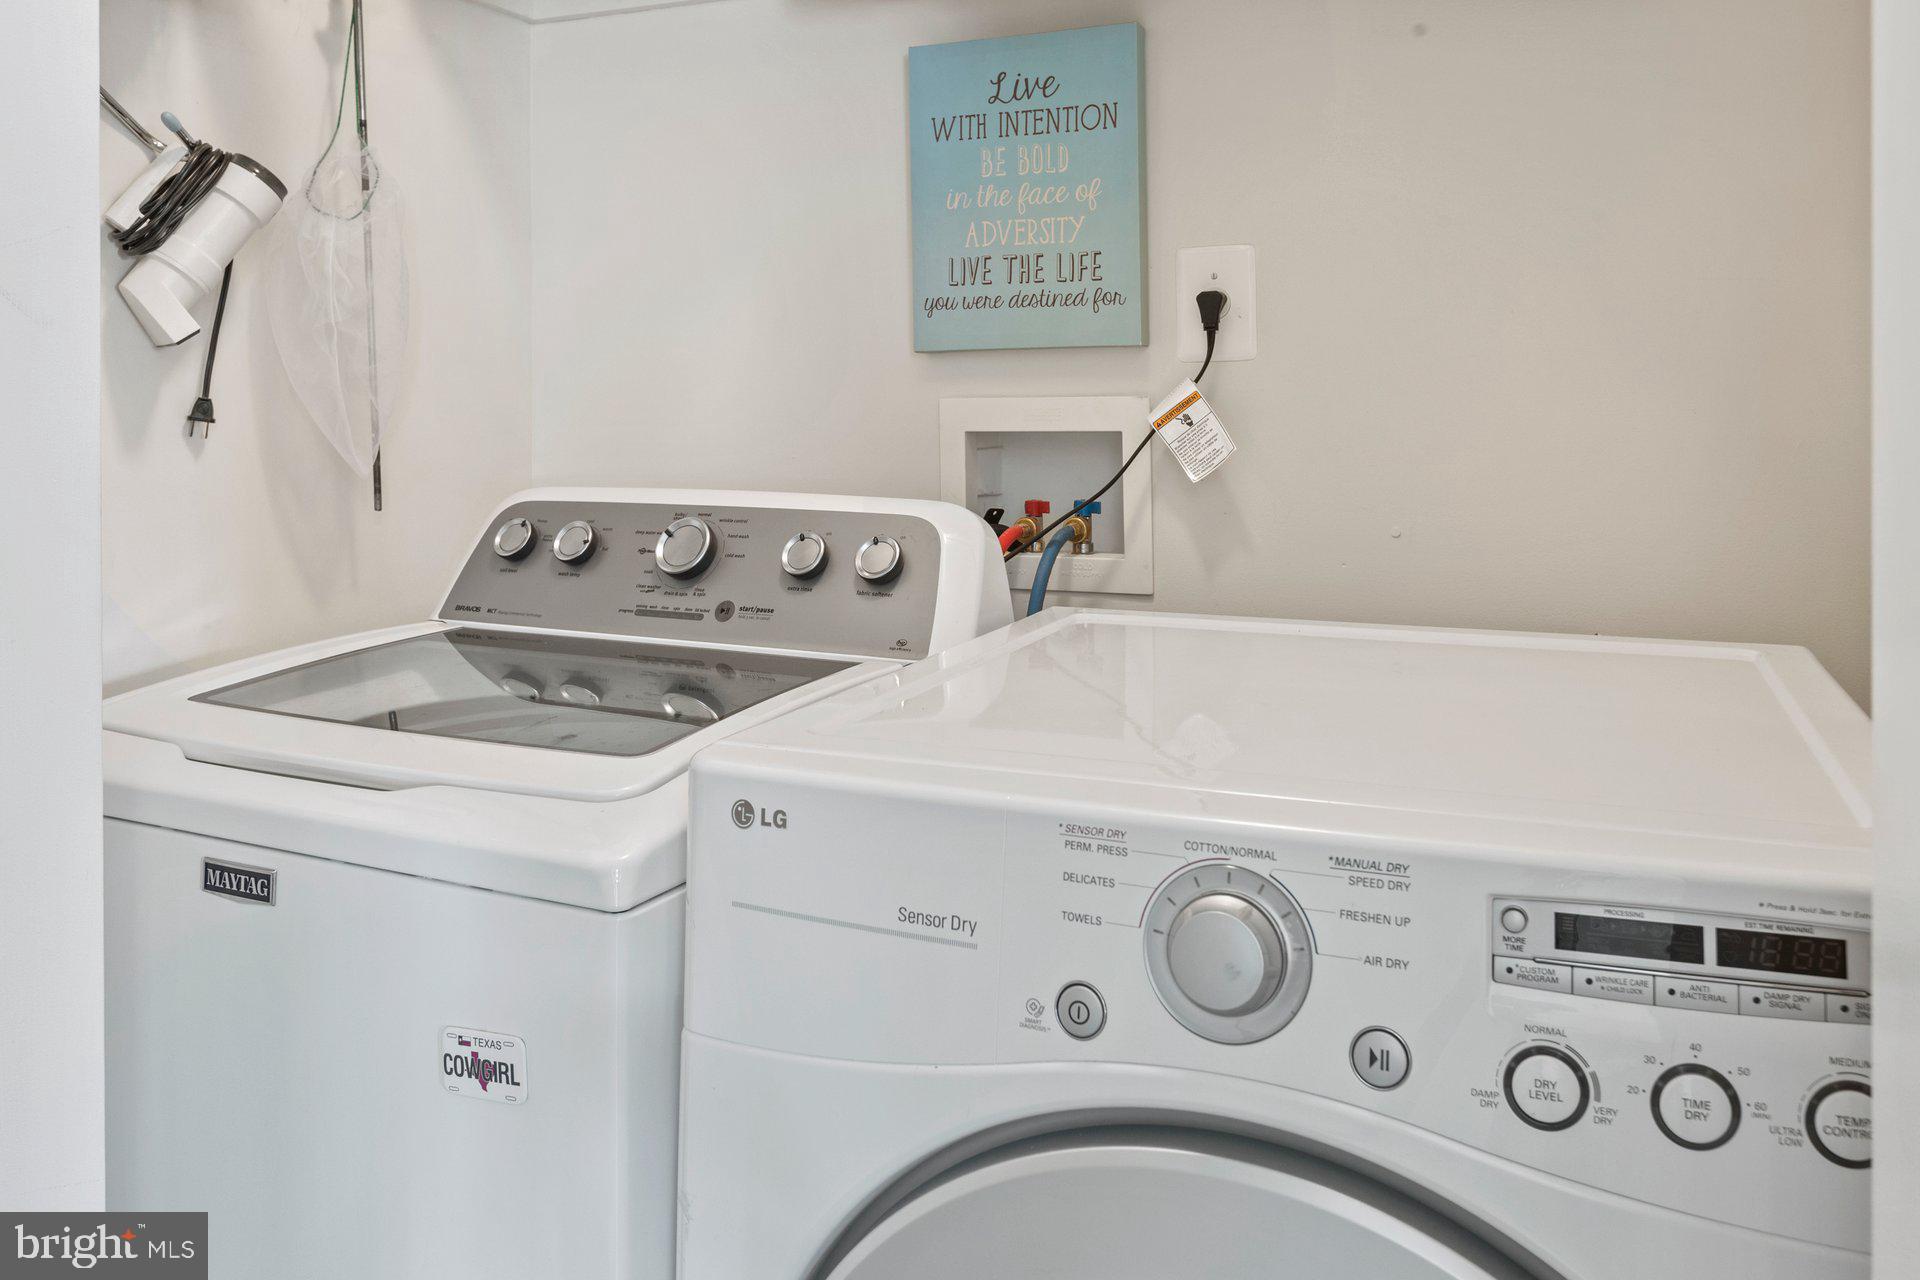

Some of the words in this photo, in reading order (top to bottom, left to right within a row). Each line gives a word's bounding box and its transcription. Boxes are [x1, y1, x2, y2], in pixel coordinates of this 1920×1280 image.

[987, 72, 1060, 104] Live
[931, 113, 988, 143] WITH
[998, 102, 1119, 138] INTENTION
[980, 147, 1007, 178] BE
[1017, 143, 1070, 176] BOLD
[946, 188, 971, 210] in
[977, 184, 1013, 208] the
[1015, 182, 1069, 216] face
[1076, 178, 1103, 211] of
[965, 216, 1085, 248] ADVERSITY
[948, 254, 993, 286] LIVE
[1003, 252, 1045, 284] THE
[1056, 250, 1103, 283] LIFE
[924, 295, 959, 318] you
[962, 294, 1004, 311] were
[1008, 288, 1088, 308] destined
[1092, 287, 1127, 314] for
[454, 604, 482, 613] BRAVOS
[738, 606, 775, 614] start/pause
[760, 808, 788, 830] LG
[1065, 824, 1105, 838] SENSOR
[1106, 828, 1128, 840] DRY
[1064, 840, 1095, 853] PERM.
[1096, 844, 1129, 858] PRESS
[1184, 840, 1278, 862] COTTON/NORMAL
[1333, 856, 1384, 872] MANUAL
[1386, 862, 1410, 874] DRY
[206, 868, 268, 897] MAYTAG
[1062, 871, 1116, 888] DELICATES
[1348, 876, 1385, 889] SPEED
[1388, 880, 1412, 892] DRY
[1061, 910, 1103, 926] TOWELS
[1338, 909, 1392, 926] FRESHEN
[1394, 916, 1412, 928] UP
[1603, 908, 1646, 919] PROCESSING
[897, 906, 947, 929] Sensor
[950, 914, 978, 937] Dry
[1502, 935, 1527, 945] MORE
[1504, 943, 1524, 952] TIME
[1362, 955, 1382, 967] AIR
[1386, 957, 1410, 970] DRY
[1519, 966, 1556, 976] CUSTOM
[1516, 973, 1560, 984] PROGRAM
[1594, 976, 1628, 986] WRINKLE
[1630, 979, 1649, 988] CARE
[1689, 984, 1710, 992] ANTI
[1680, 990, 1728, 1004] BACTERIAL
[1764, 991, 1791, 1002] DAMP
[1792, 994, 1811, 1004] DRY
[1768, 1000, 1802, 1011] SIGNAL
[1524, 1024, 1568, 1038] NORMAL
[472, 1036, 502, 1050] TEXAS
[1689, 1043, 1702, 1052] 40
[1643, 1054, 1656, 1064] 30
[443, 1052, 521, 1087] COWGIRL
[1737, 1067, 1750, 1076] 50
[1534, 1078, 1558, 1089] DRY
[1470, 1088, 1500, 1099] DAMP
[1528, 1090, 1564, 1103] LEVEL
[1626, 1086, 1640, 1095] 20
[1480, 1100, 1500, 1110] DRY
[1681, 1097, 1712, 1111] TIME
[1754, 1102, 1768, 1112] 60
[1593, 1106, 1618, 1117] VERY
[1684, 1110, 1709, 1122] DRY
[1593, 1116, 1613, 1126] DRY
[1768, 1125, 1804, 1138] ULTRA
[1778, 1136, 1804, 1148] LOW
